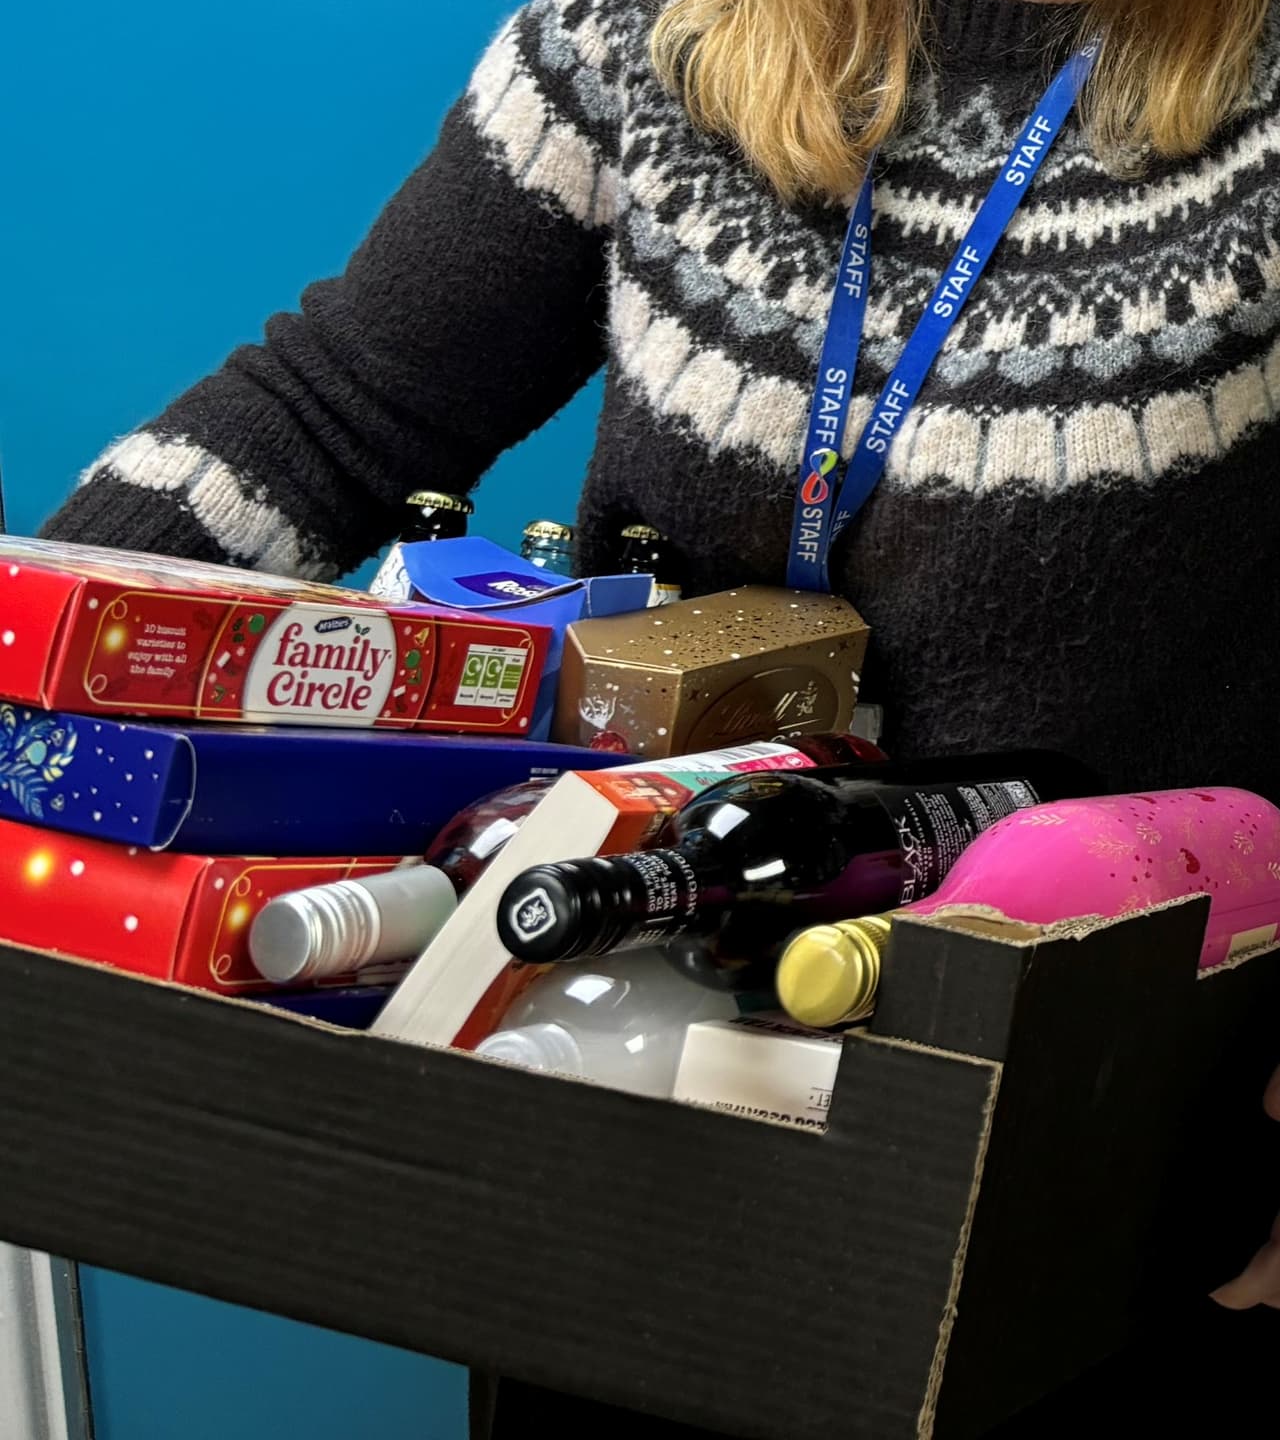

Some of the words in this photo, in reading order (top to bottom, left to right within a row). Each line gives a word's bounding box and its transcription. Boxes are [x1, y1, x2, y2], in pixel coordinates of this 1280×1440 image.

[1005, 115, 1053, 186] STAFF
[842, 223, 868, 299] STAFF
[934, 246, 980, 317] STAFF
[815, 368, 847, 445] STAFF
[866, 380, 910, 453] STAFF
[797, 507, 823, 563] STAFF
[128, 651, 150, 664] enjoy
[130, 665, 145, 675] the
[148, 665, 176, 678] family
[273, 623, 391, 680] family
[267, 671, 372, 710] Circle
[895, 816, 921, 905] BLACK
